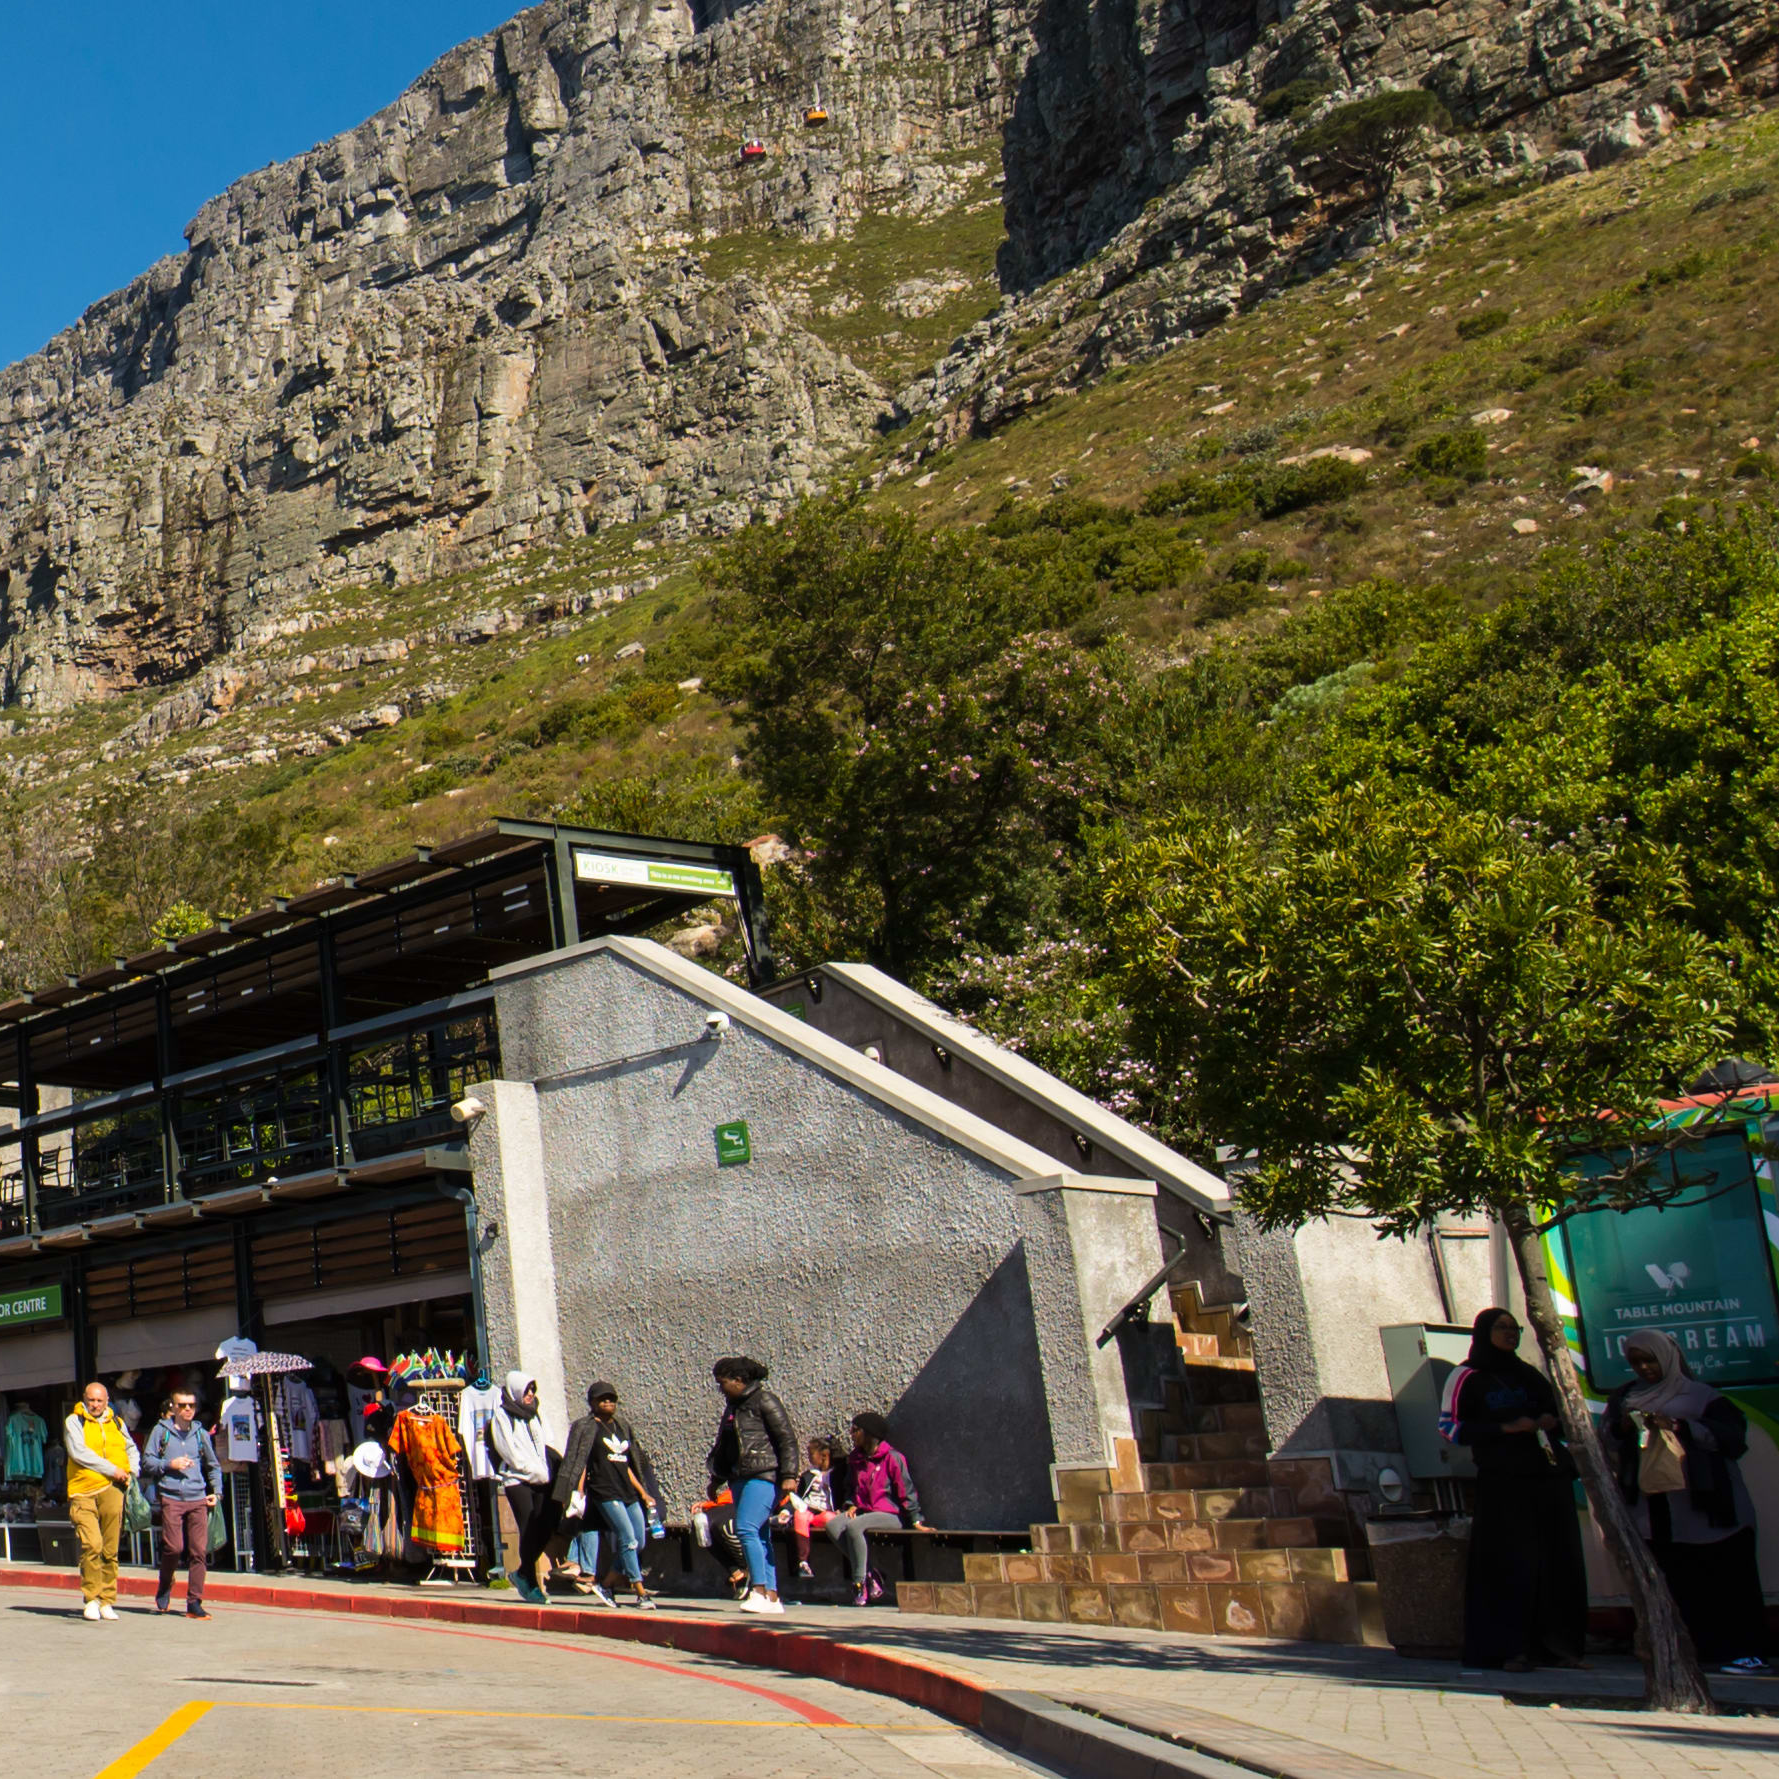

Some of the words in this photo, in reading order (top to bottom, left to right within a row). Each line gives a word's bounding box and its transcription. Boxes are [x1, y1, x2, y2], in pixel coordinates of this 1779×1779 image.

[583, 860, 618, 874] KIOSK
[12, 1296, 47, 1315] CENTRE
[1614, 1305, 1659, 1320] TABLE
[1662, 1298, 1741, 1316] MOUNTAIN
